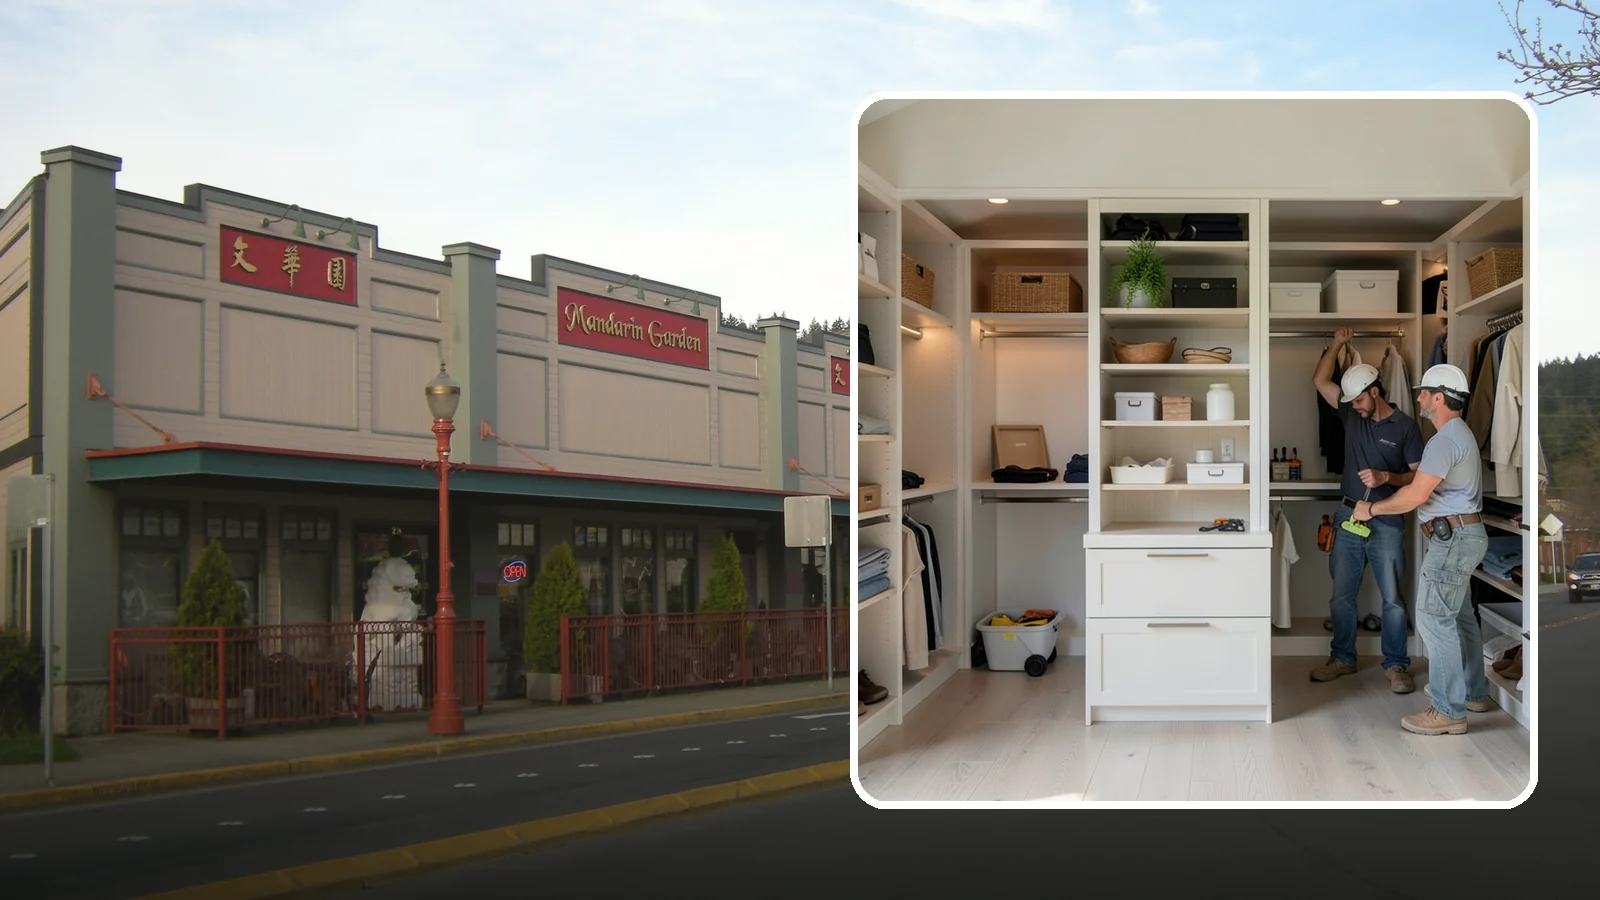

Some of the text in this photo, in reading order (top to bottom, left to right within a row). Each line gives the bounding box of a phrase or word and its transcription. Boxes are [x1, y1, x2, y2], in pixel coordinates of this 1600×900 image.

[564, 302, 701, 352] Mandarin Garden
[503, 565, 527, 578] OPEN
